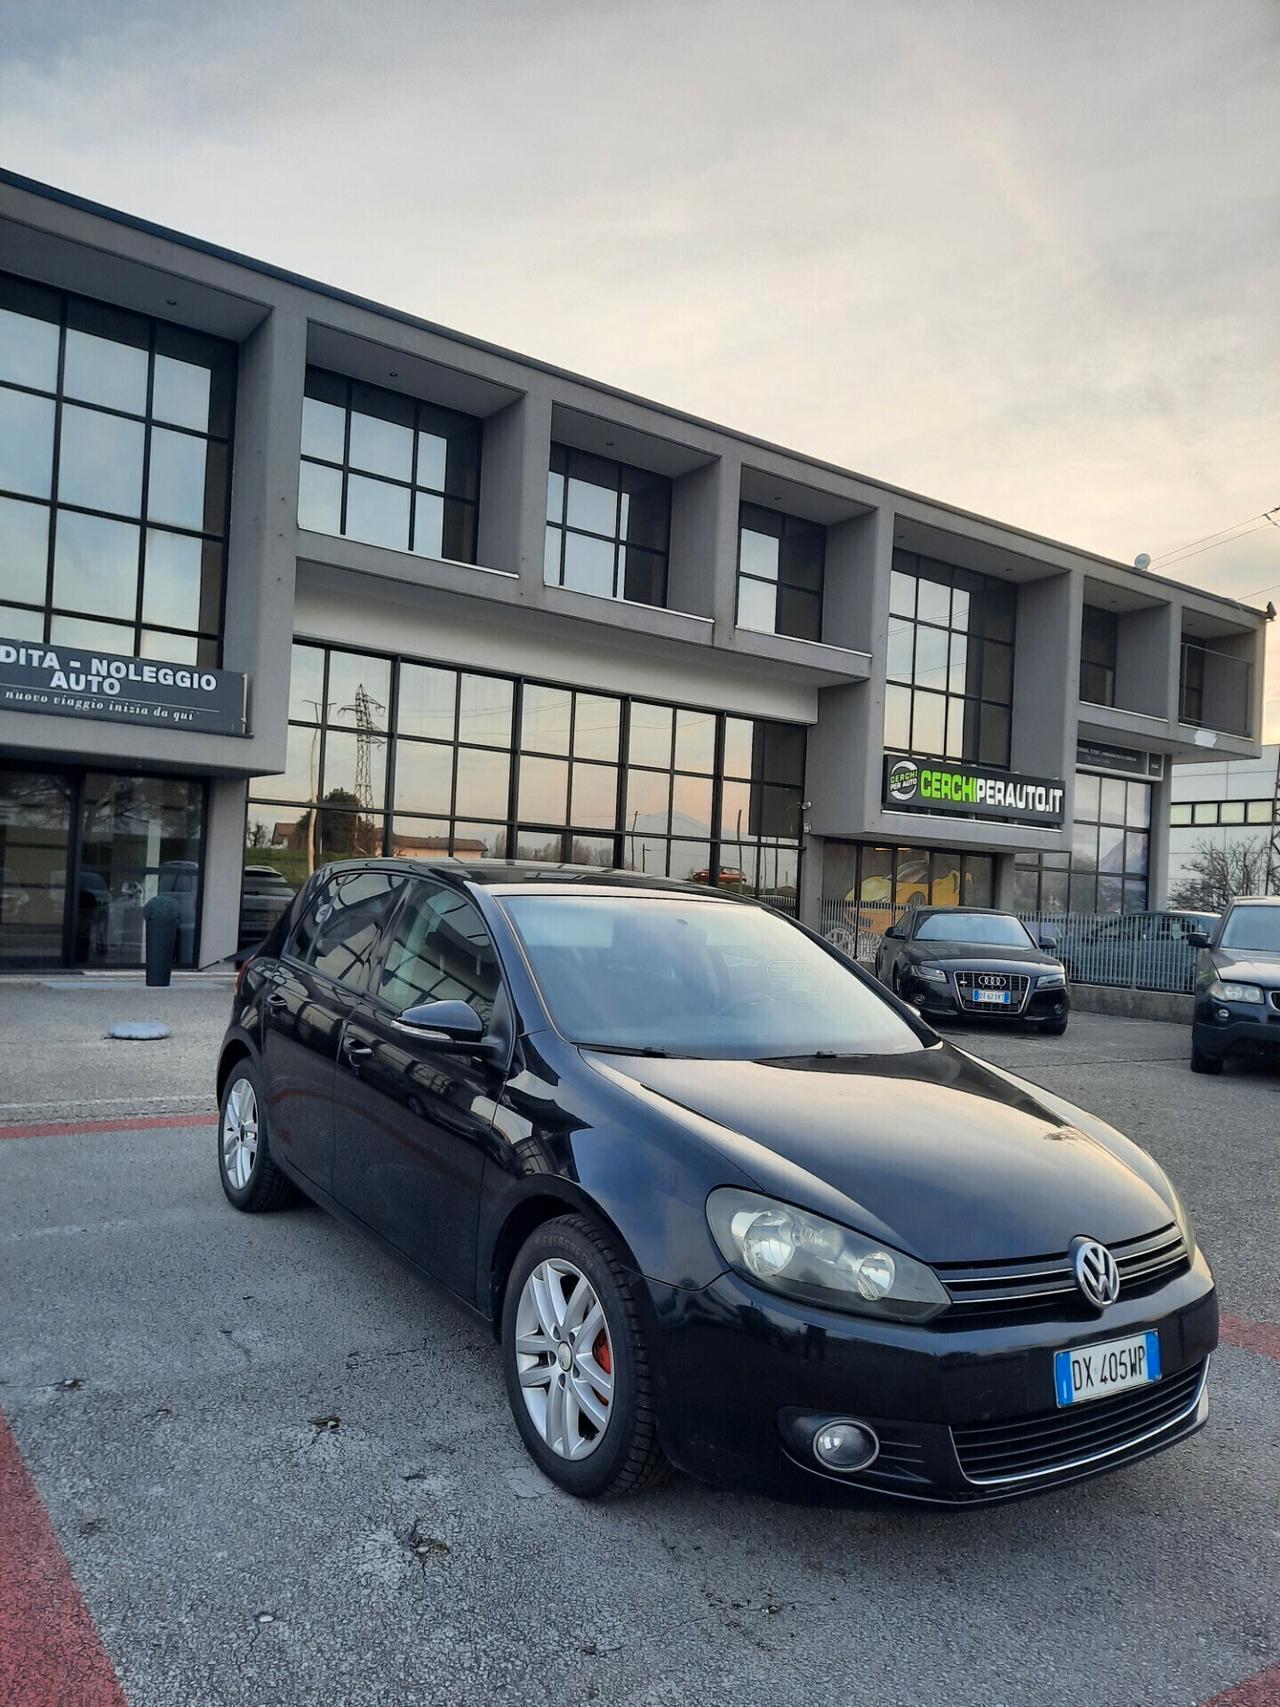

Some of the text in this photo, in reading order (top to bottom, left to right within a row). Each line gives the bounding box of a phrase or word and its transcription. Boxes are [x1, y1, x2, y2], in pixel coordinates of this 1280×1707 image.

[0, 645, 60, 669] DITA
[91, 658, 217, 691] NOLEGGIO
[50, 671, 121, 695] AUTO
[5, 690, 194, 722] nuovo viaggio inizia da qui
[890, 770, 918, 783] CERCHI
[920, 770, 1063, 813] CERCHIPERAUTO.IT
[1072, 1357, 1094, 1391] DX
